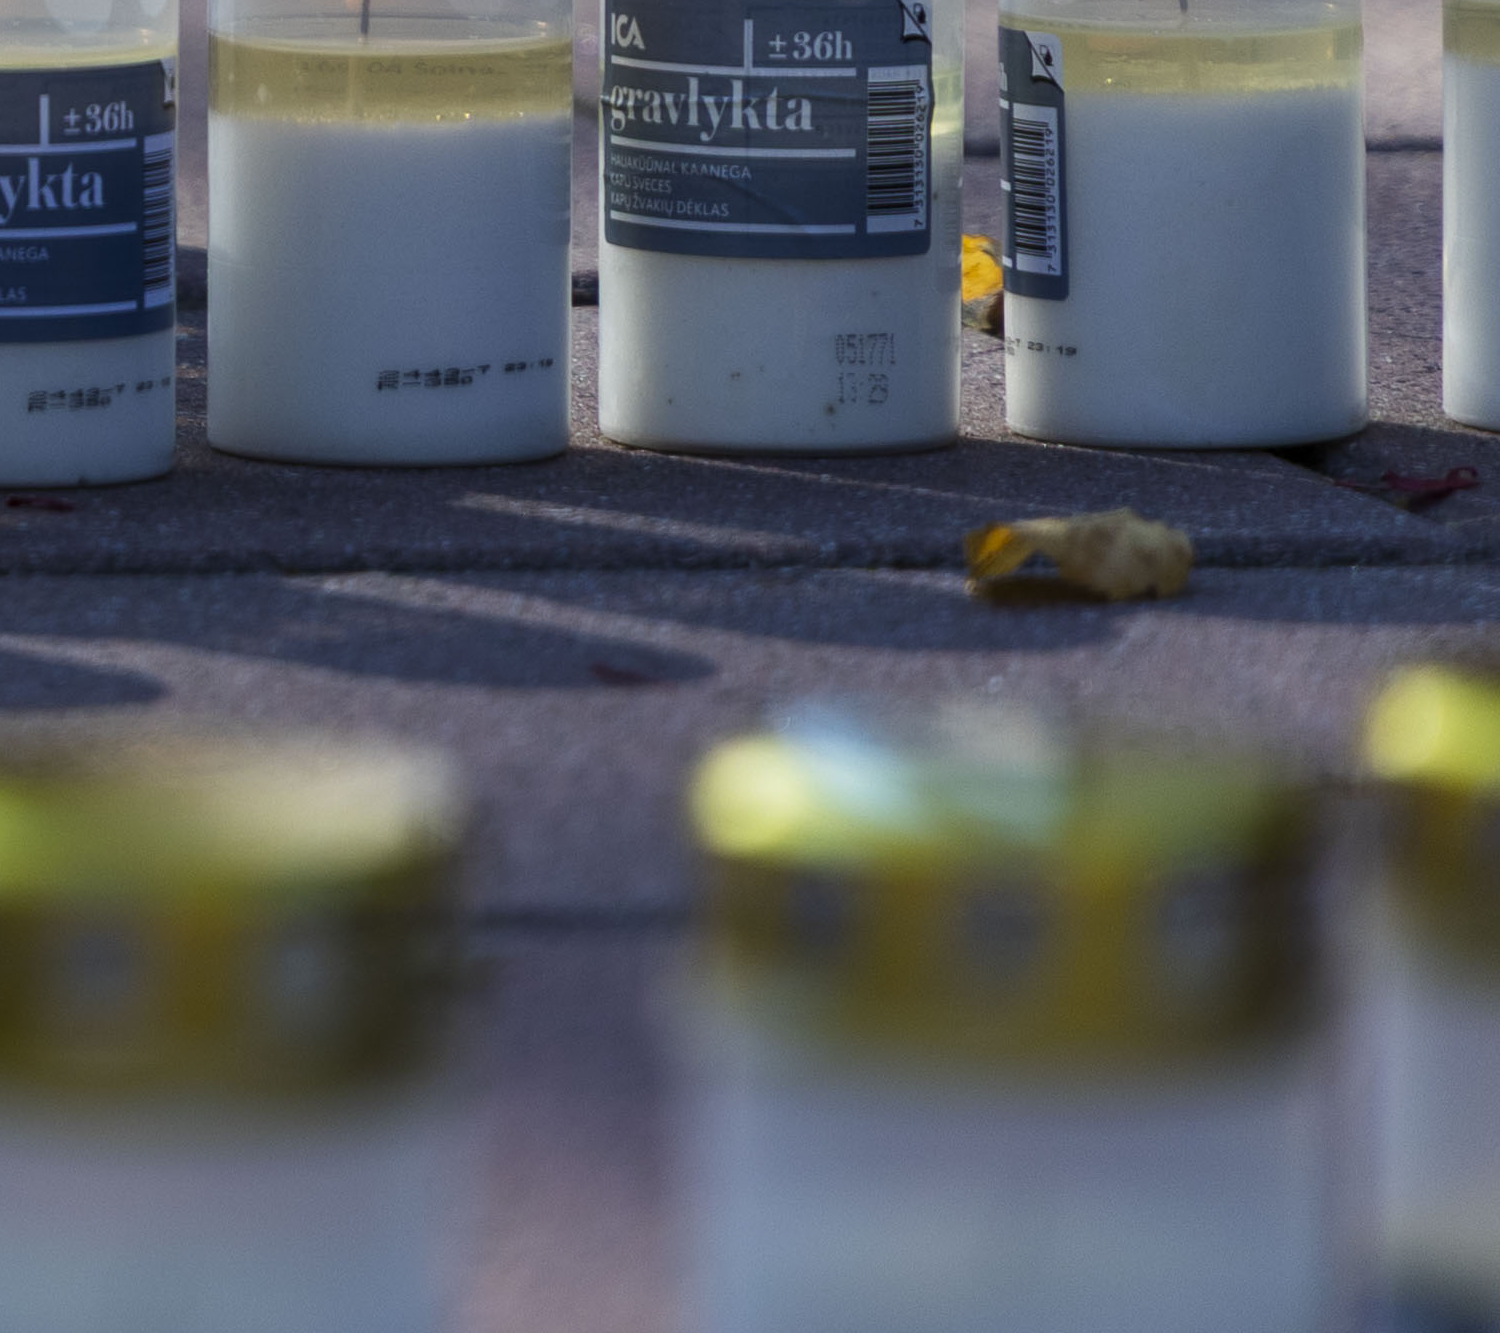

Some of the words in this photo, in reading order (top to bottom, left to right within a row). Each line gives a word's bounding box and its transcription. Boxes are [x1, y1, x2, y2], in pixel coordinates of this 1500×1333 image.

[610, 12, 646, 50] ICA
[610, 76, 815, 142] gravlykta
[680, 161, 753, 181] KAANEGA
